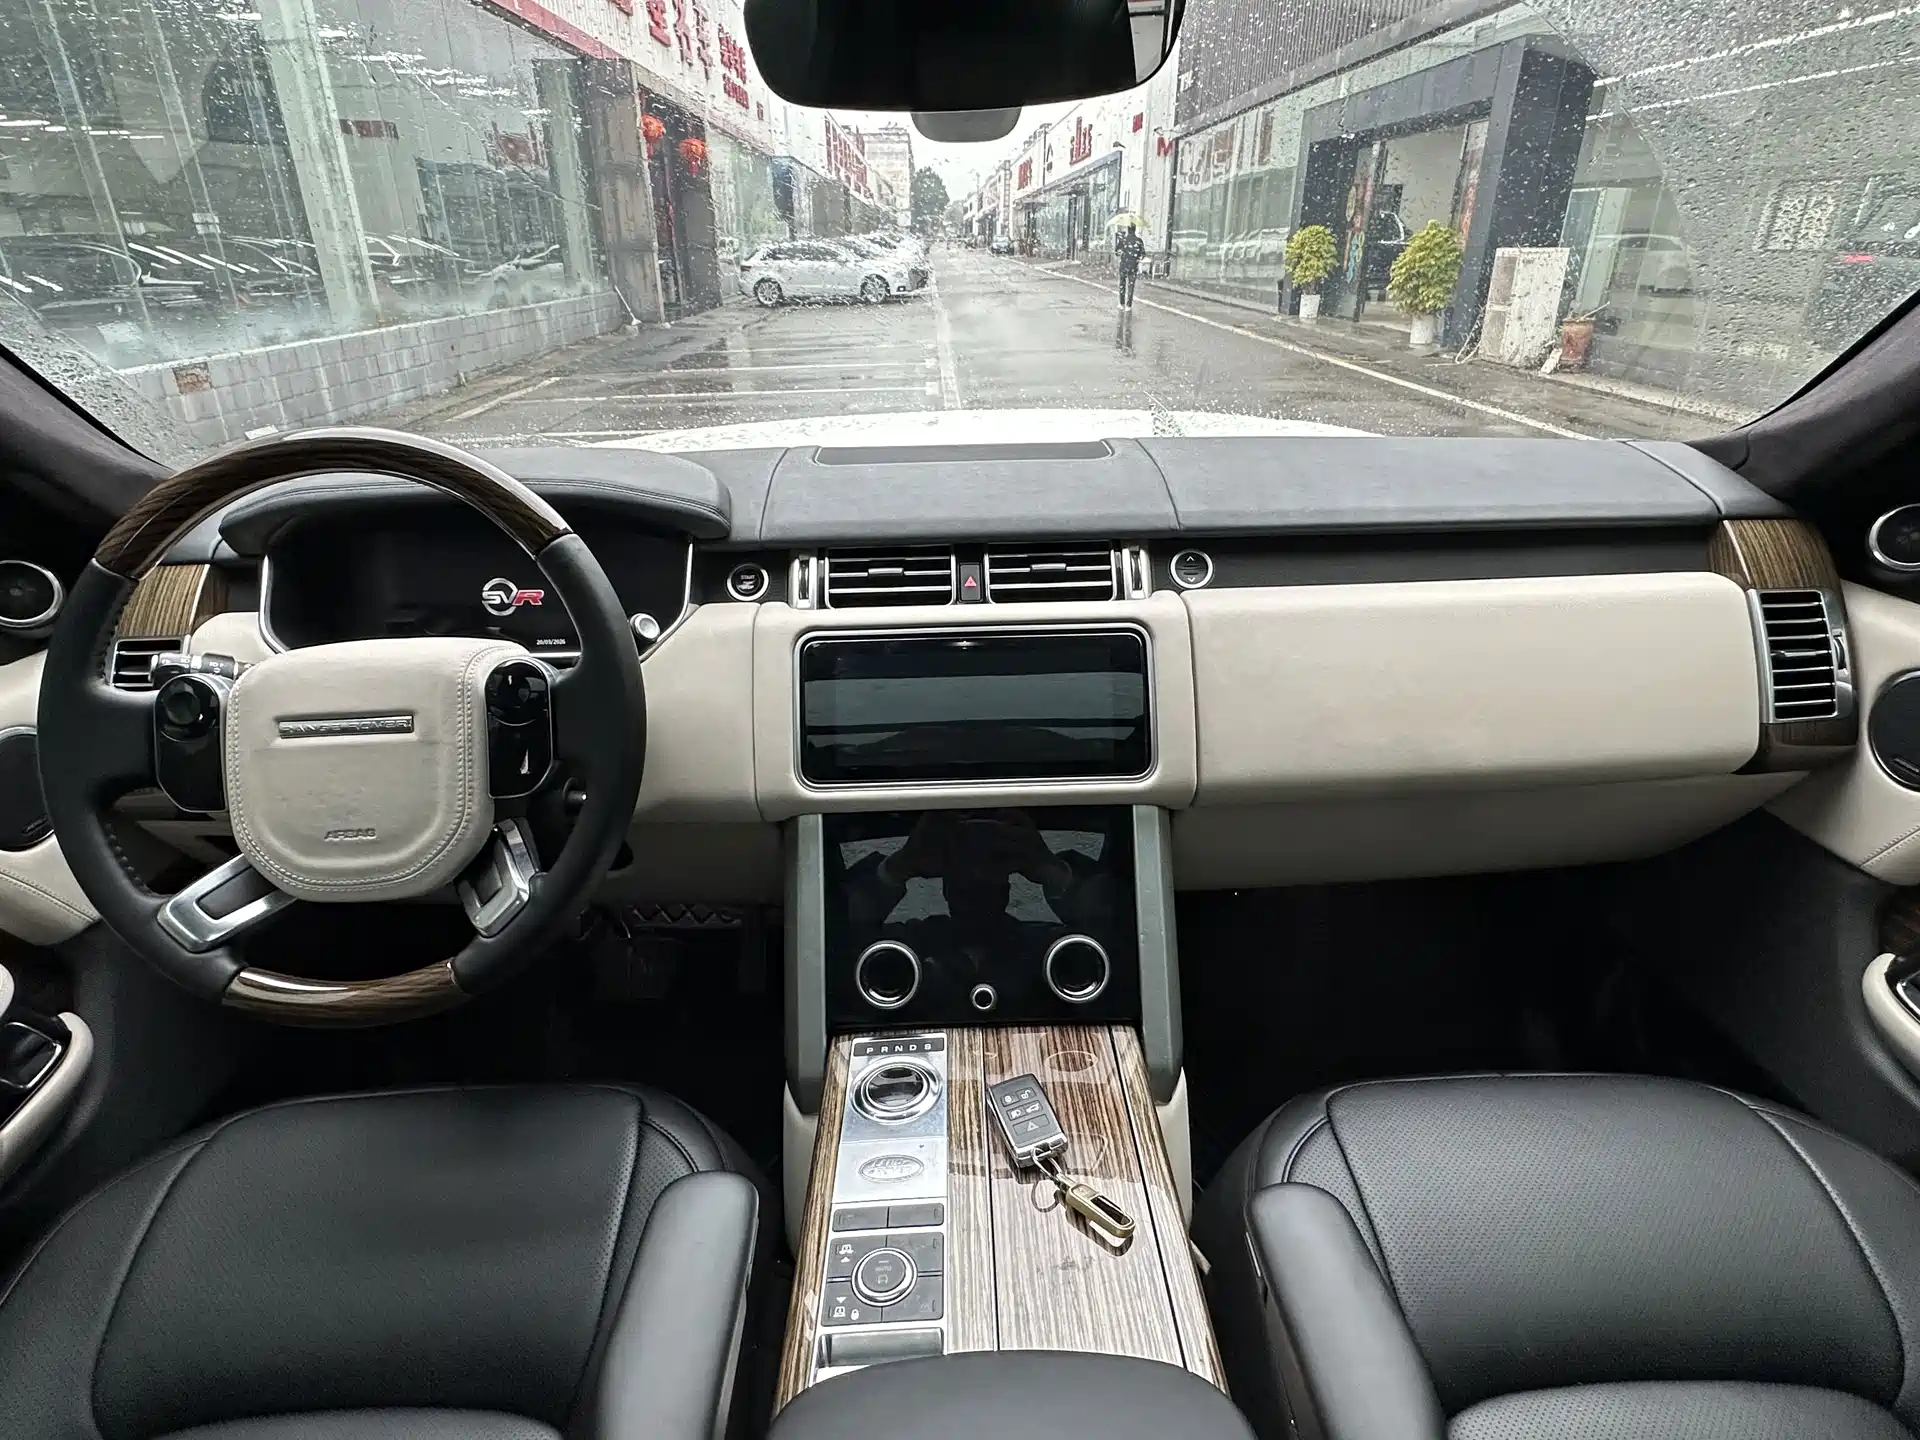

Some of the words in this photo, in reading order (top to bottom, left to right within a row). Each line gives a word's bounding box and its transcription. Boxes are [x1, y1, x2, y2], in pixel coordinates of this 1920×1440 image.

[482, 588, 545, 606] SVR
[280, 722, 342, 733] RANGE
[347, 719, 412, 731] ROVER
